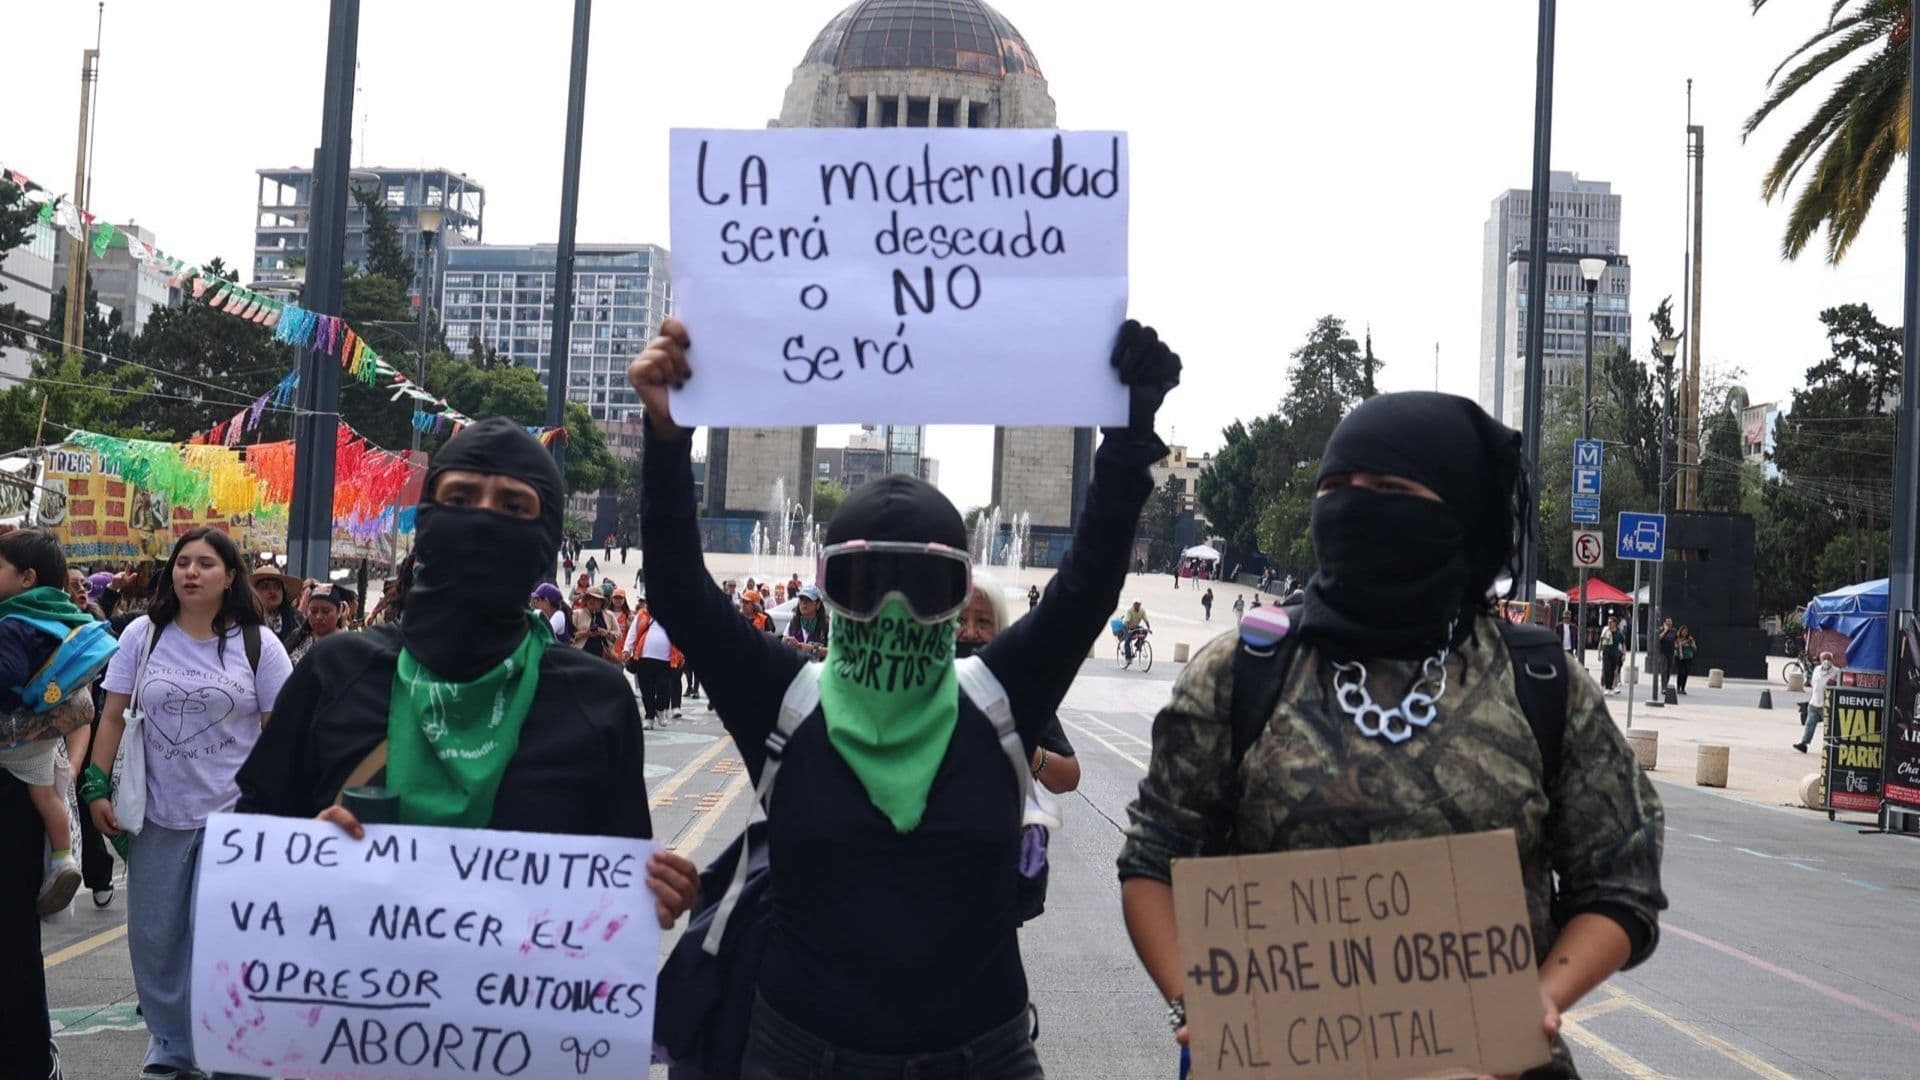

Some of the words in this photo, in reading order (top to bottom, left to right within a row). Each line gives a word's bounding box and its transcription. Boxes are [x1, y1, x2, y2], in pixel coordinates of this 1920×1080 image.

[697, 140, 769, 207] LA
[820, 134, 1120, 207] maternidad
[875, 210, 1066, 260] deseada
[800, 284, 829, 311] o
[892, 264, 982, 317] NO
[49, 452, 92, 473] TACOS
[1577, 470, 1596, 494] E
[216, 828, 266, 864] SI
[285, 832, 340, 866] DE
[365, 835, 418, 863] MI
[450, 844, 636, 890] VIENTRE
[231, 901, 286, 937] VA
[309, 905, 337, 942] A
[369, 905, 503, 947] NACER
[531, 920, 584, 951] EL
[1204, 881, 1267, 931] ME
[1291, 871, 1411, 924] NIEGO
[1329, 935, 1378, 989] UN
[1393, 922, 1533, 984] OBRERO
[243, 959, 442, 1002] OPRESOR
[476, 972, 647, 1017] ENTONCES
[320, 1017, 533, 1078] ABORTO
[1218, 1022, 1271, 1071] AL
[1288, 1009, 1454, 1067] CAPITAL
